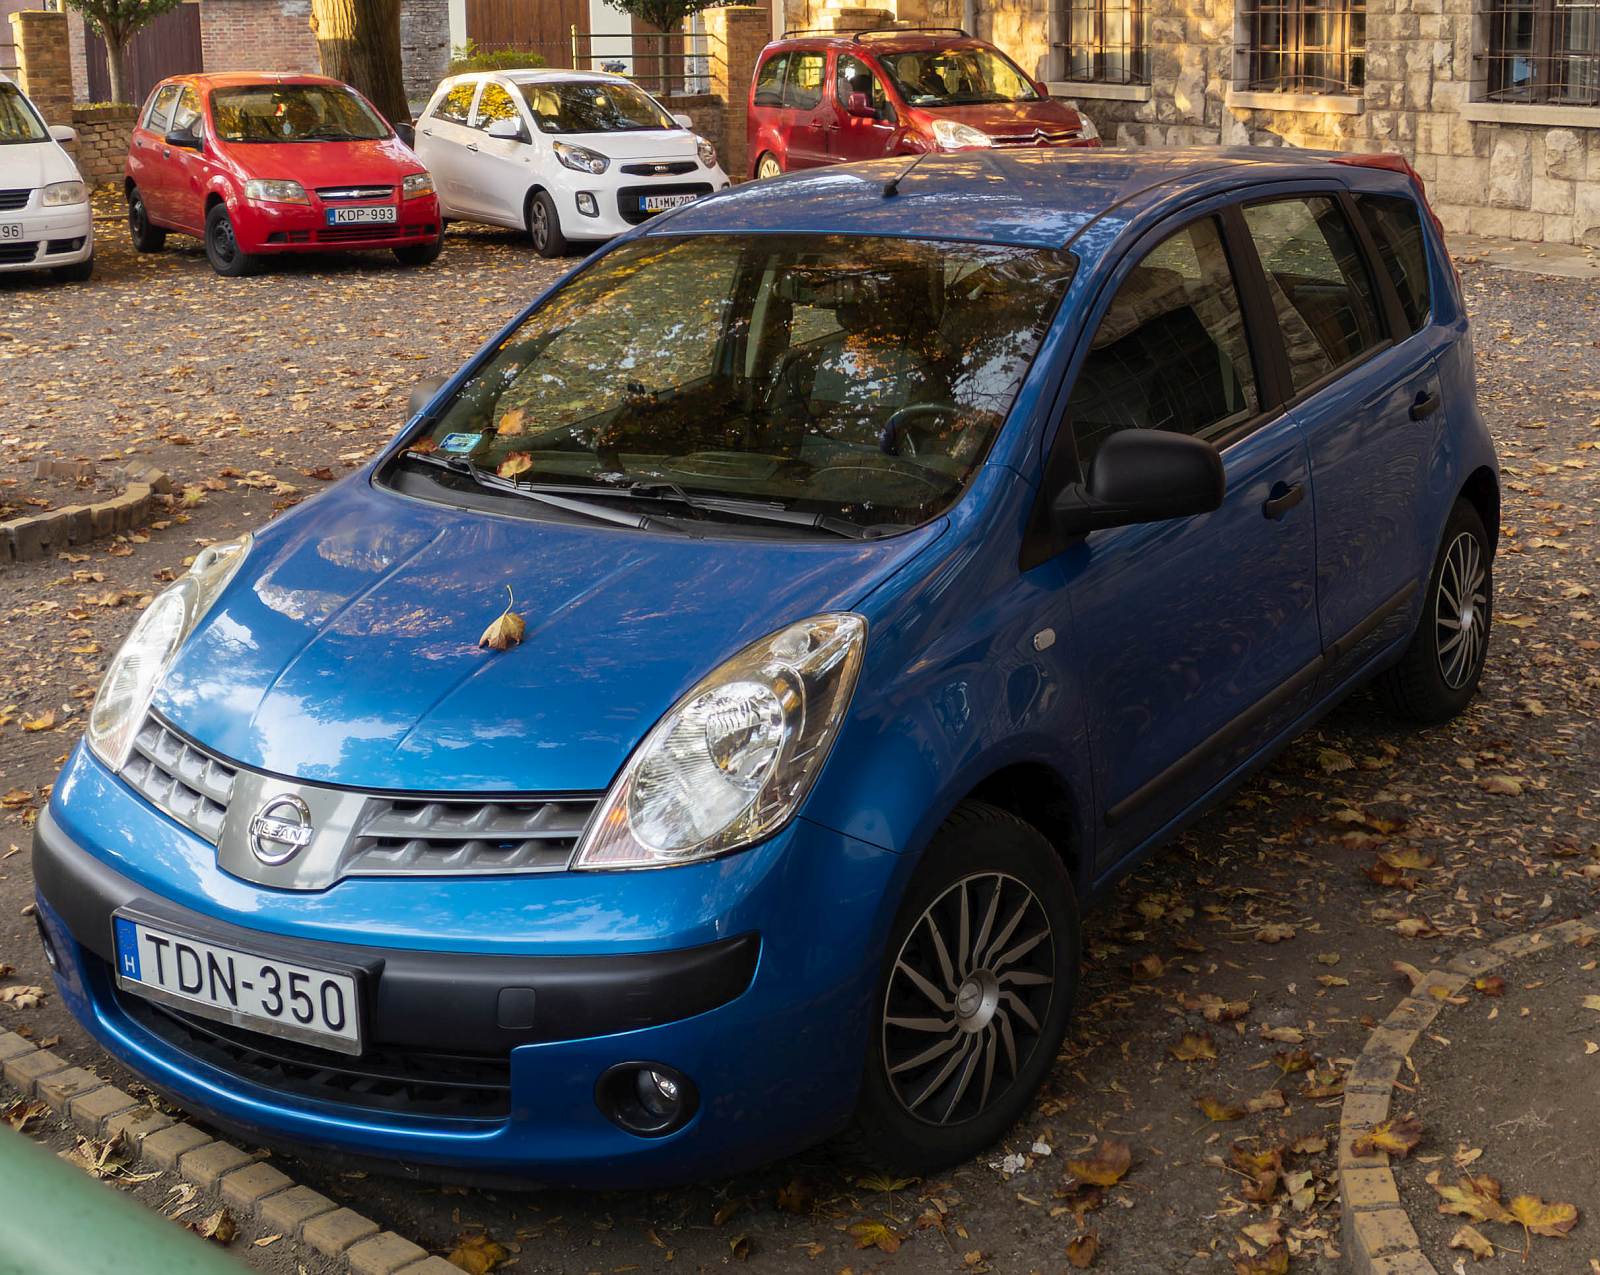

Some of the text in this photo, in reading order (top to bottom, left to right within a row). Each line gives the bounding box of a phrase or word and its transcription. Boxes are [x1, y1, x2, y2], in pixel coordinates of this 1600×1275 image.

[337, 208, 394, 221] KDP-993
[2, 225, 19, 238] 96
[252, 818, 303, 842] NISSAN
[124, 933, 346, 1032] H TDN-350
